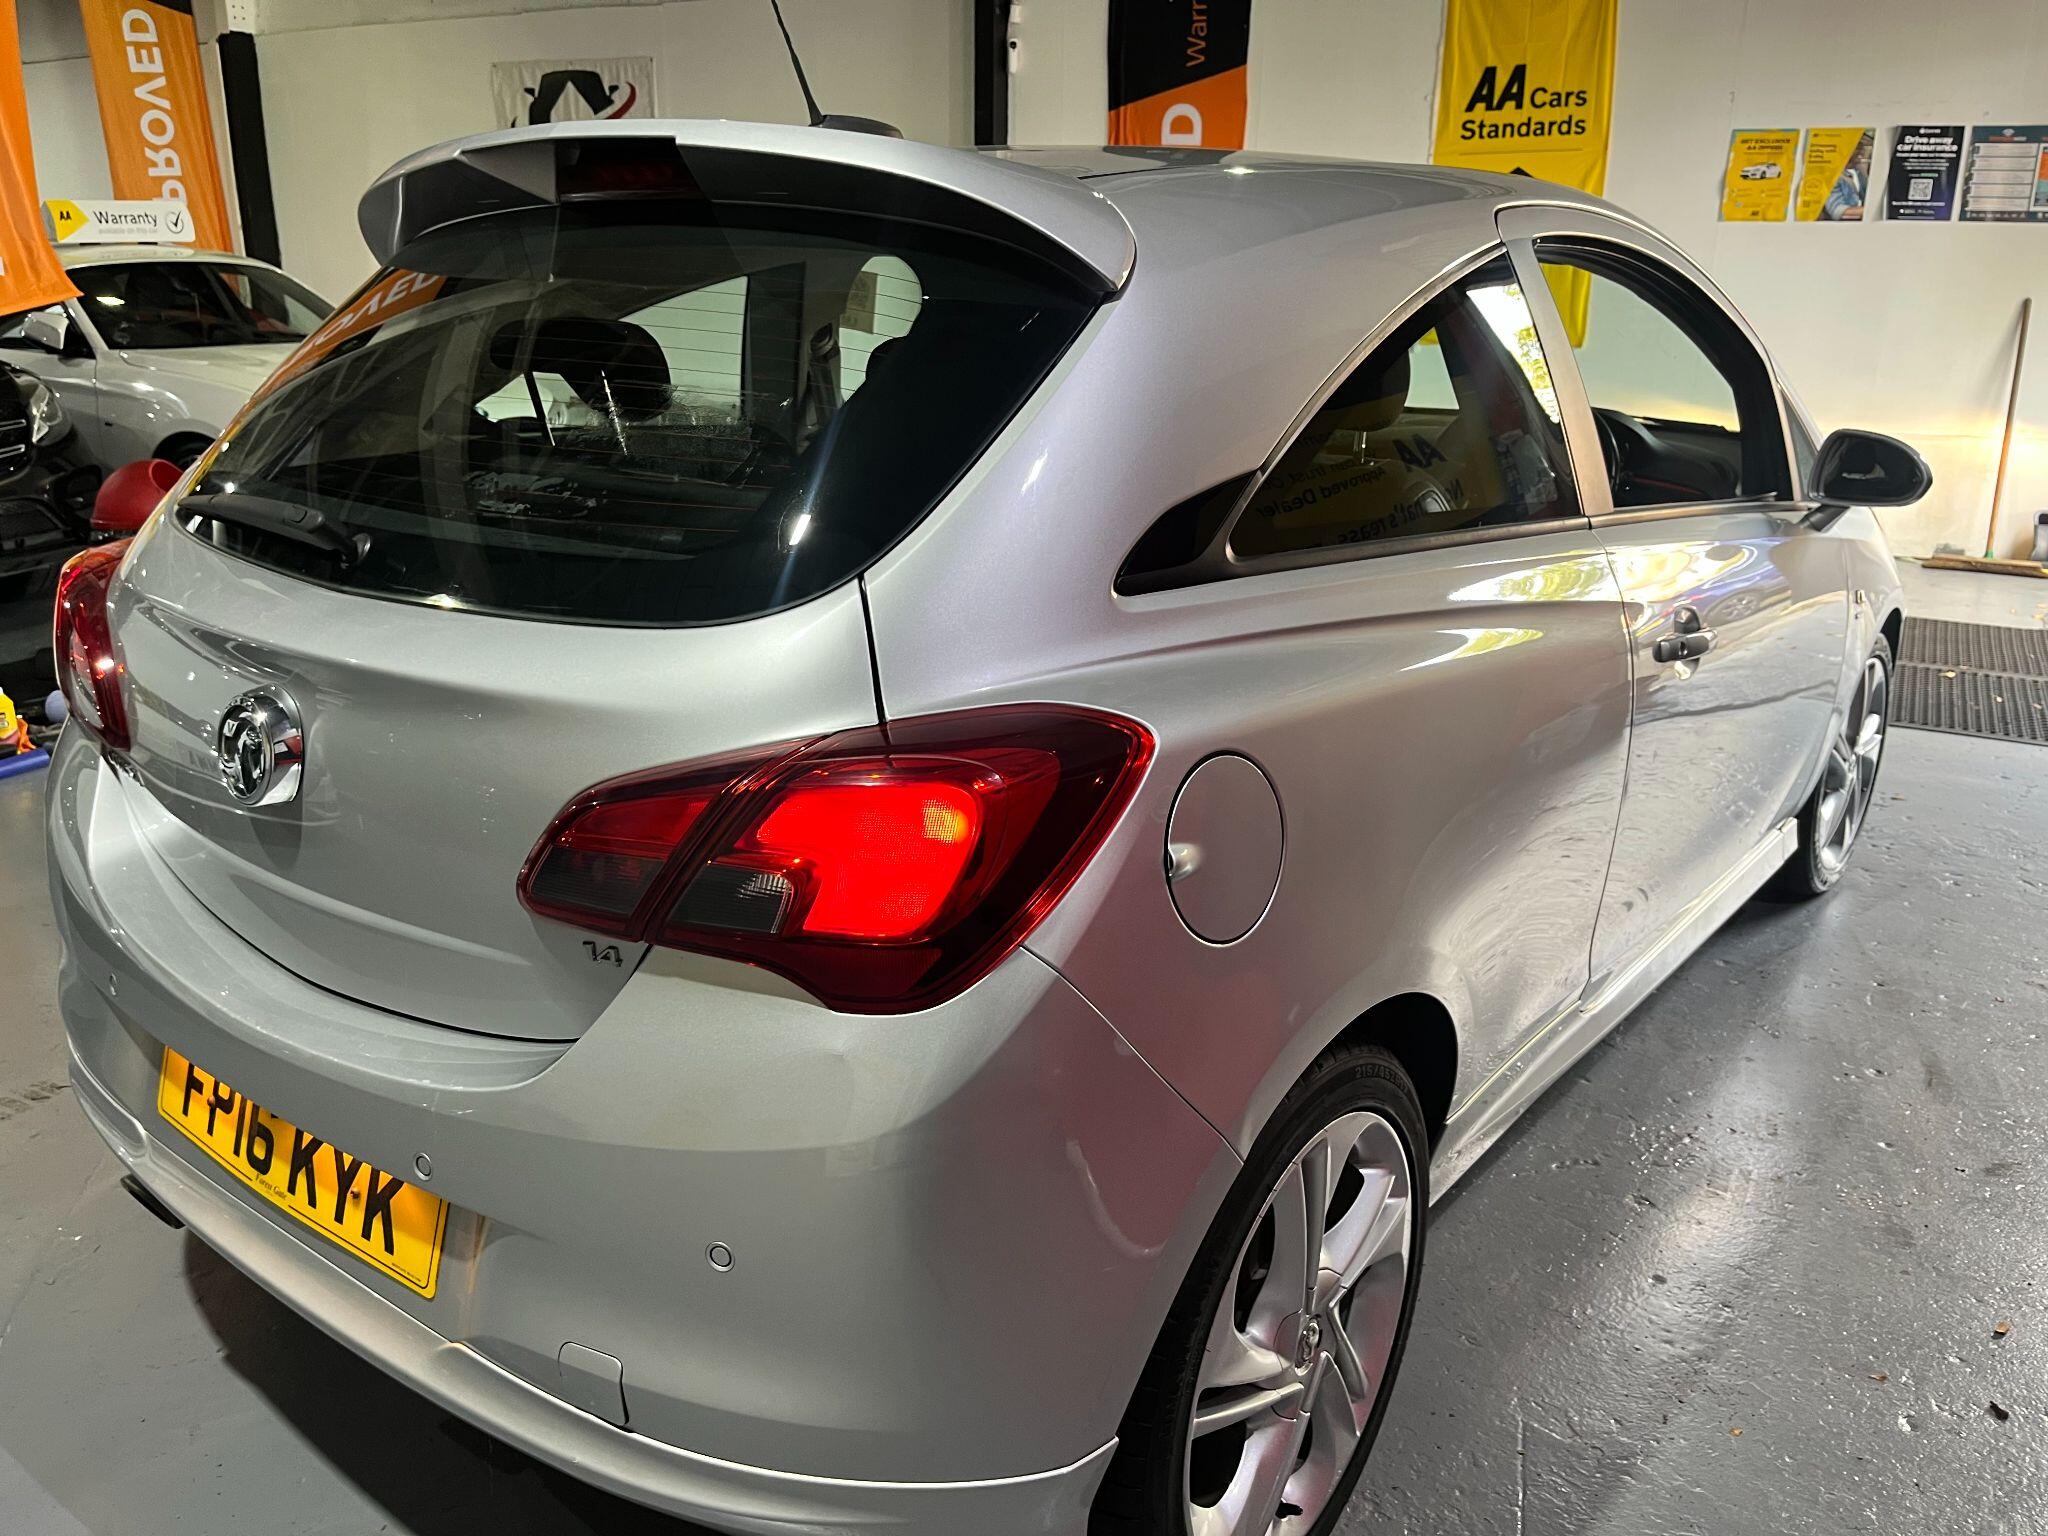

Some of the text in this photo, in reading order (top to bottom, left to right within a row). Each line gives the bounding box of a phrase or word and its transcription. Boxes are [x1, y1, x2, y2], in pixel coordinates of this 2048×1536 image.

[1464, 64, 1588, 113] AA Cars
[1460, 115, 1587, 140] Standards
[59, 209, 158, 227] AA Warranty
[182, 1062, 405, 1256] FP16 KYK
